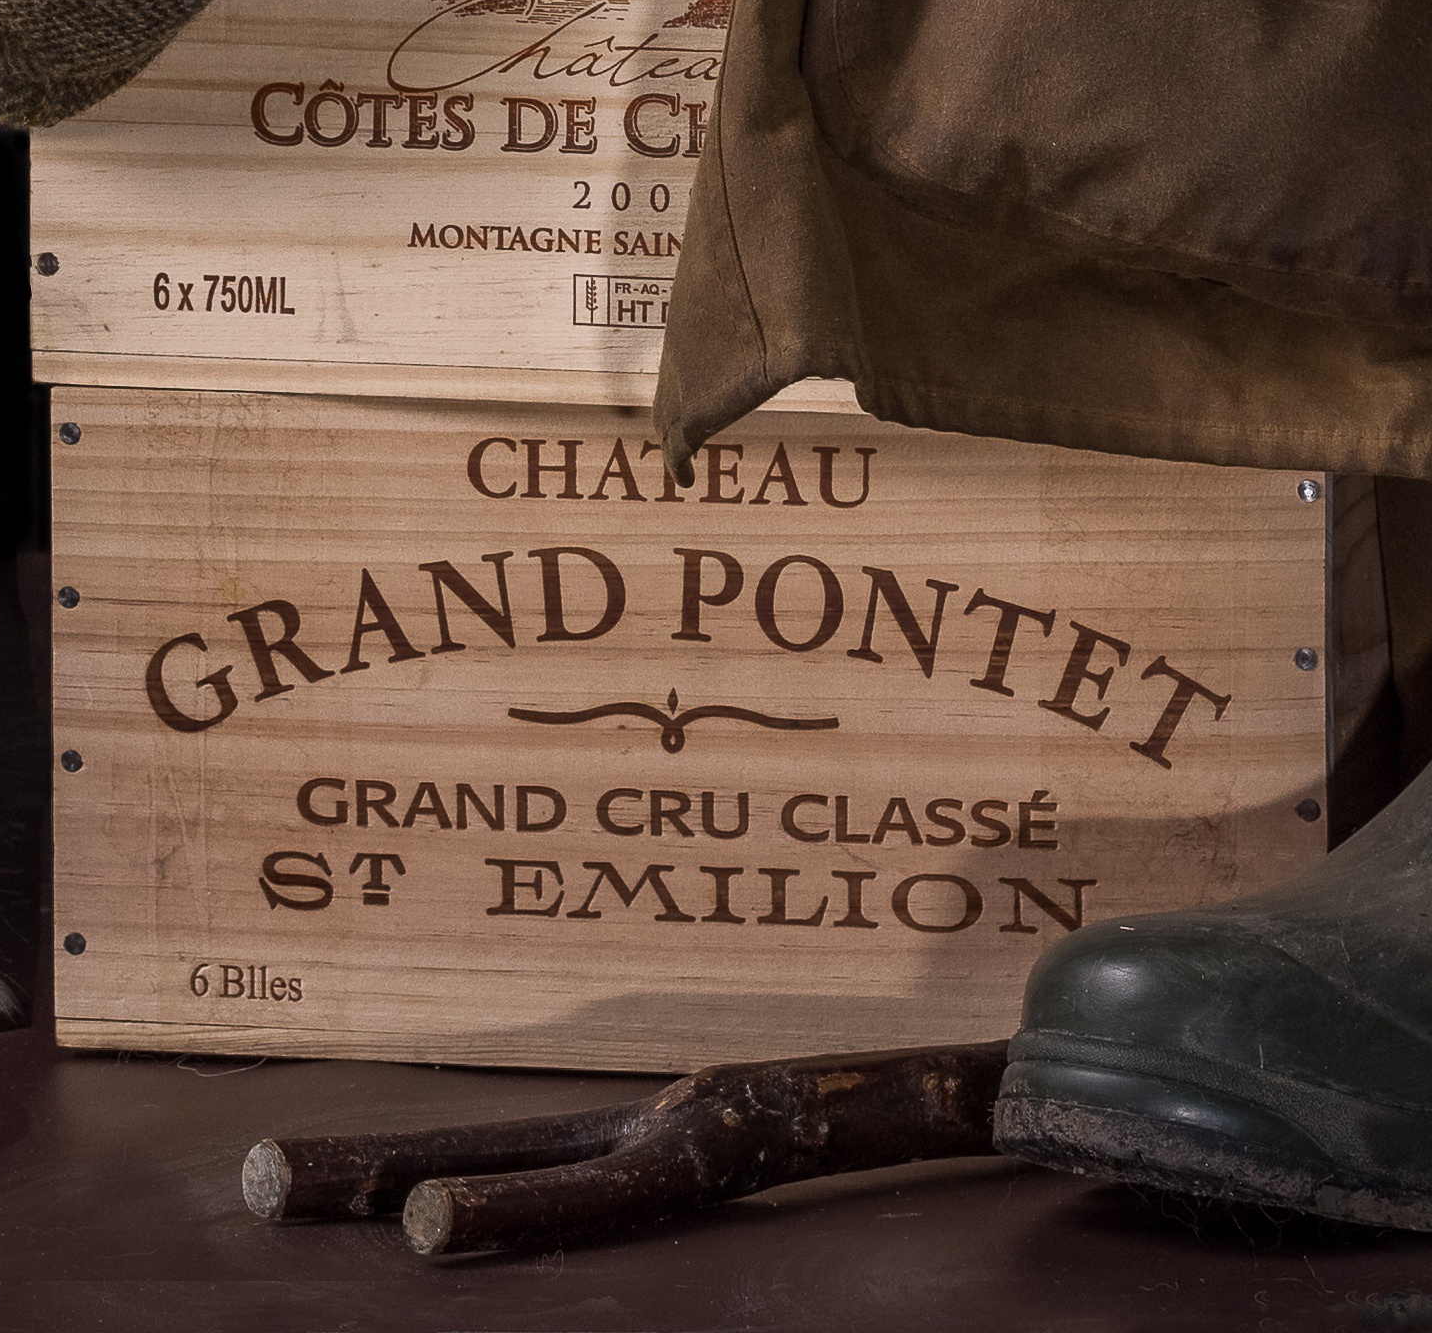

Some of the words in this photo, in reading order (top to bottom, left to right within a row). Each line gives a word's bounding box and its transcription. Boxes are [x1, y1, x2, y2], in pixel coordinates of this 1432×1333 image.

[251, 78, 477, 153] CÔTES
[500, 95, 598, 155] DE
[572, 180, 693, 214] 200
[407, 222, 602, 255] MONTAGNE
[153, 273, 170, 310] 6
[178, 283, 193, 312] x
[202, 275, 296, 315] 750ML
[617, 299, 654, 323] HT
[145, 546, 626, 734] GRAND
[671, 547, 1232, 771] PONTET
[296, 777, 567, 832] GRAND
[596, 788, 750, 839] CRU
[780, 790, 1059, 850] CLASSÉ
[485, 858, 1098, 934] EMILION
[190, 963, 209, 997] 6
[219, 964, 303, 1002] Blles
